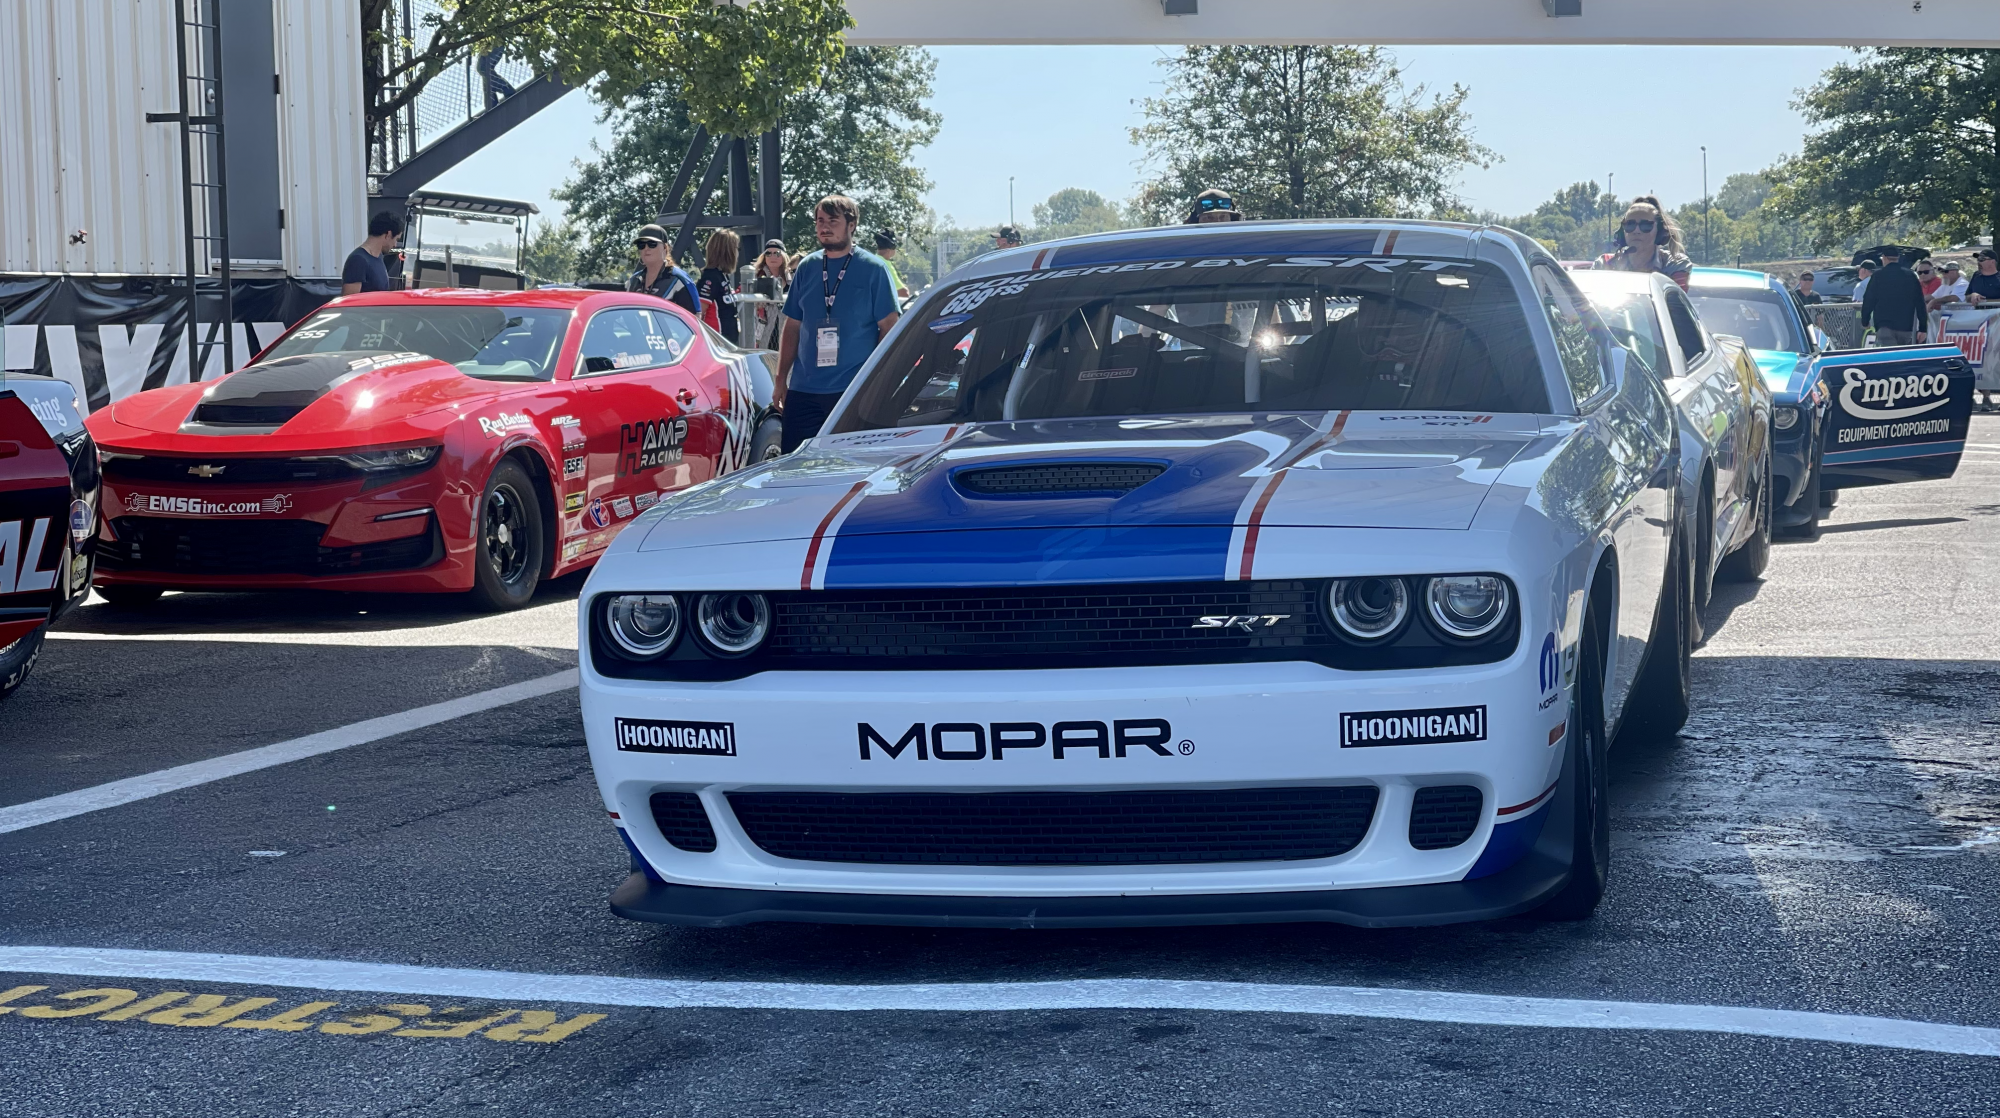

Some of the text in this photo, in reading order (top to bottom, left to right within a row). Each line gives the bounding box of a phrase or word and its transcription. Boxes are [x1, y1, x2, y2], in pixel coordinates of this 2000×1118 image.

[947, 256, 1475, 297] POWERED BY SRT
[940, 283, 1029, 316] 689 FSS
[301, 313, 342, 330] 7
[638, 310, 654, 334] 7
[289, 330, 330, 340] FSS
[645, 335, 667, 350] FSS
[1082, 368, 1133, 379] dragpak
[1839, 367, 1950, 420] Empaco
[478, 416, 506, 437] Ray
[1838, 418, 1950, 443] EQUIPMENT CORPORATION
[617, 416, 688, 478] HAMP
[563, 457, 585, 475] JESEL
[640, 447, 683, 467] RACING
[149, 495, 261, 514] EMSGinc.com
[1191, 614, 1292, 632] SRT
[1538, 693, 1558, 712] MOPAR
